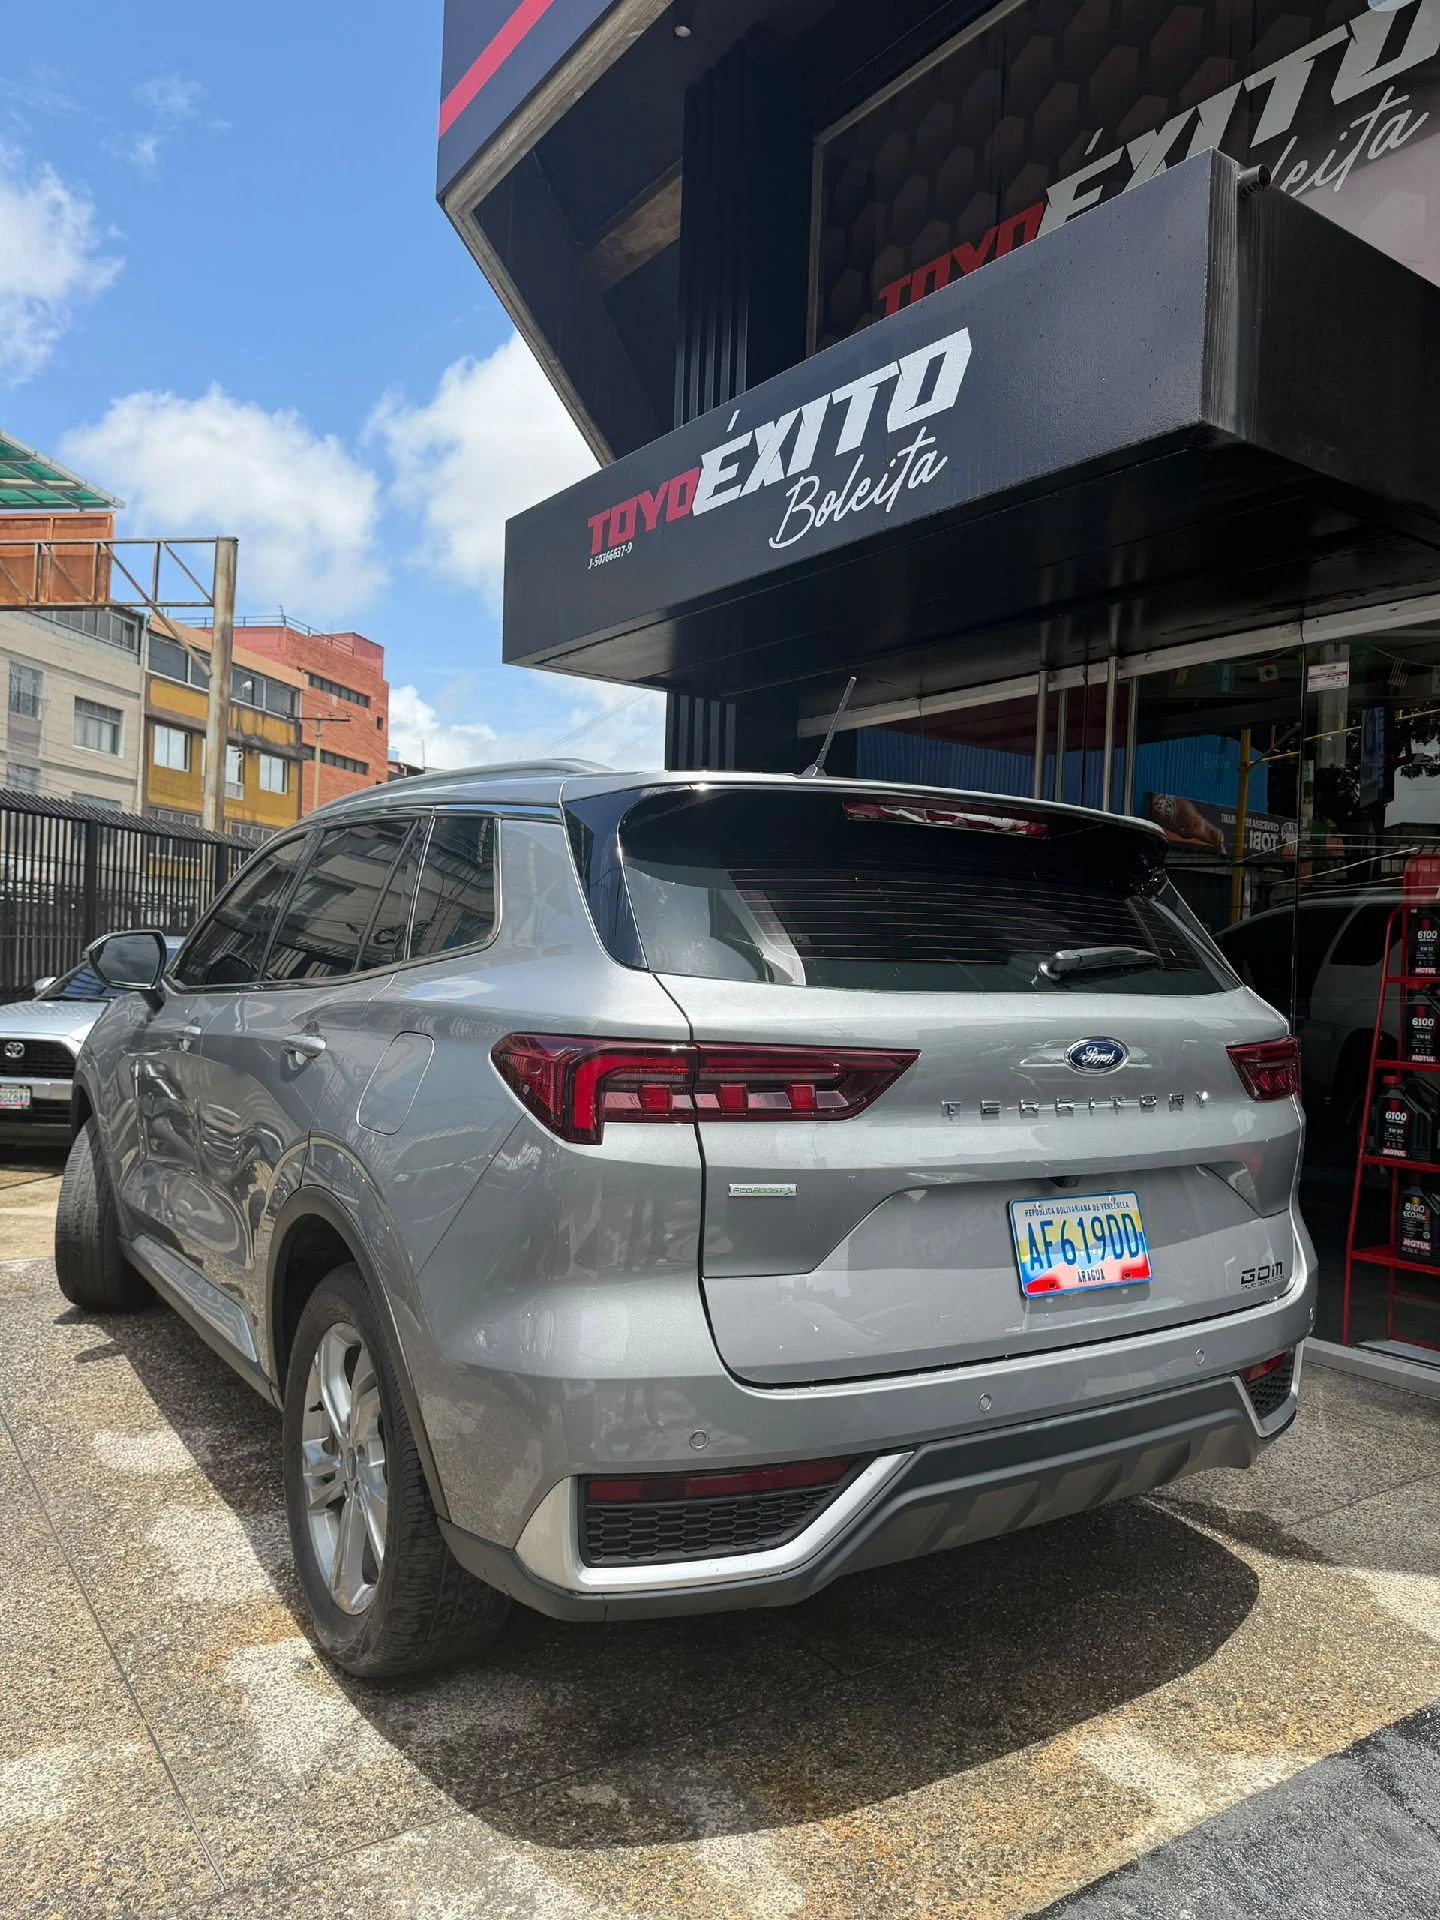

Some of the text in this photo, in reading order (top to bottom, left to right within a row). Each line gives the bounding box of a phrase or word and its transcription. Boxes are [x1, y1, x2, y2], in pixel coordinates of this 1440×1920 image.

[768, 426, 948, 549] Boleita
[1418, 930, 1437, 939] 6100
[1412, 1017, 1434, 1026] 6100
[1082, 1046, 1116, 1065] Ford
[1385, 1111, 1407, 1121] 6100
[1056, 1204, 1092, 1215] BOLIVARIANA
[1092, 1203, 1100, 1212] DE
[1100, 1201, 1130, 1211] VENEZUELA
[1027, 1212, 1141, 1271] AF619DD
[1403, 1238, 1431, 1251] MOTUL
[1077, 1267, 1106, 1284] ARAGUA
